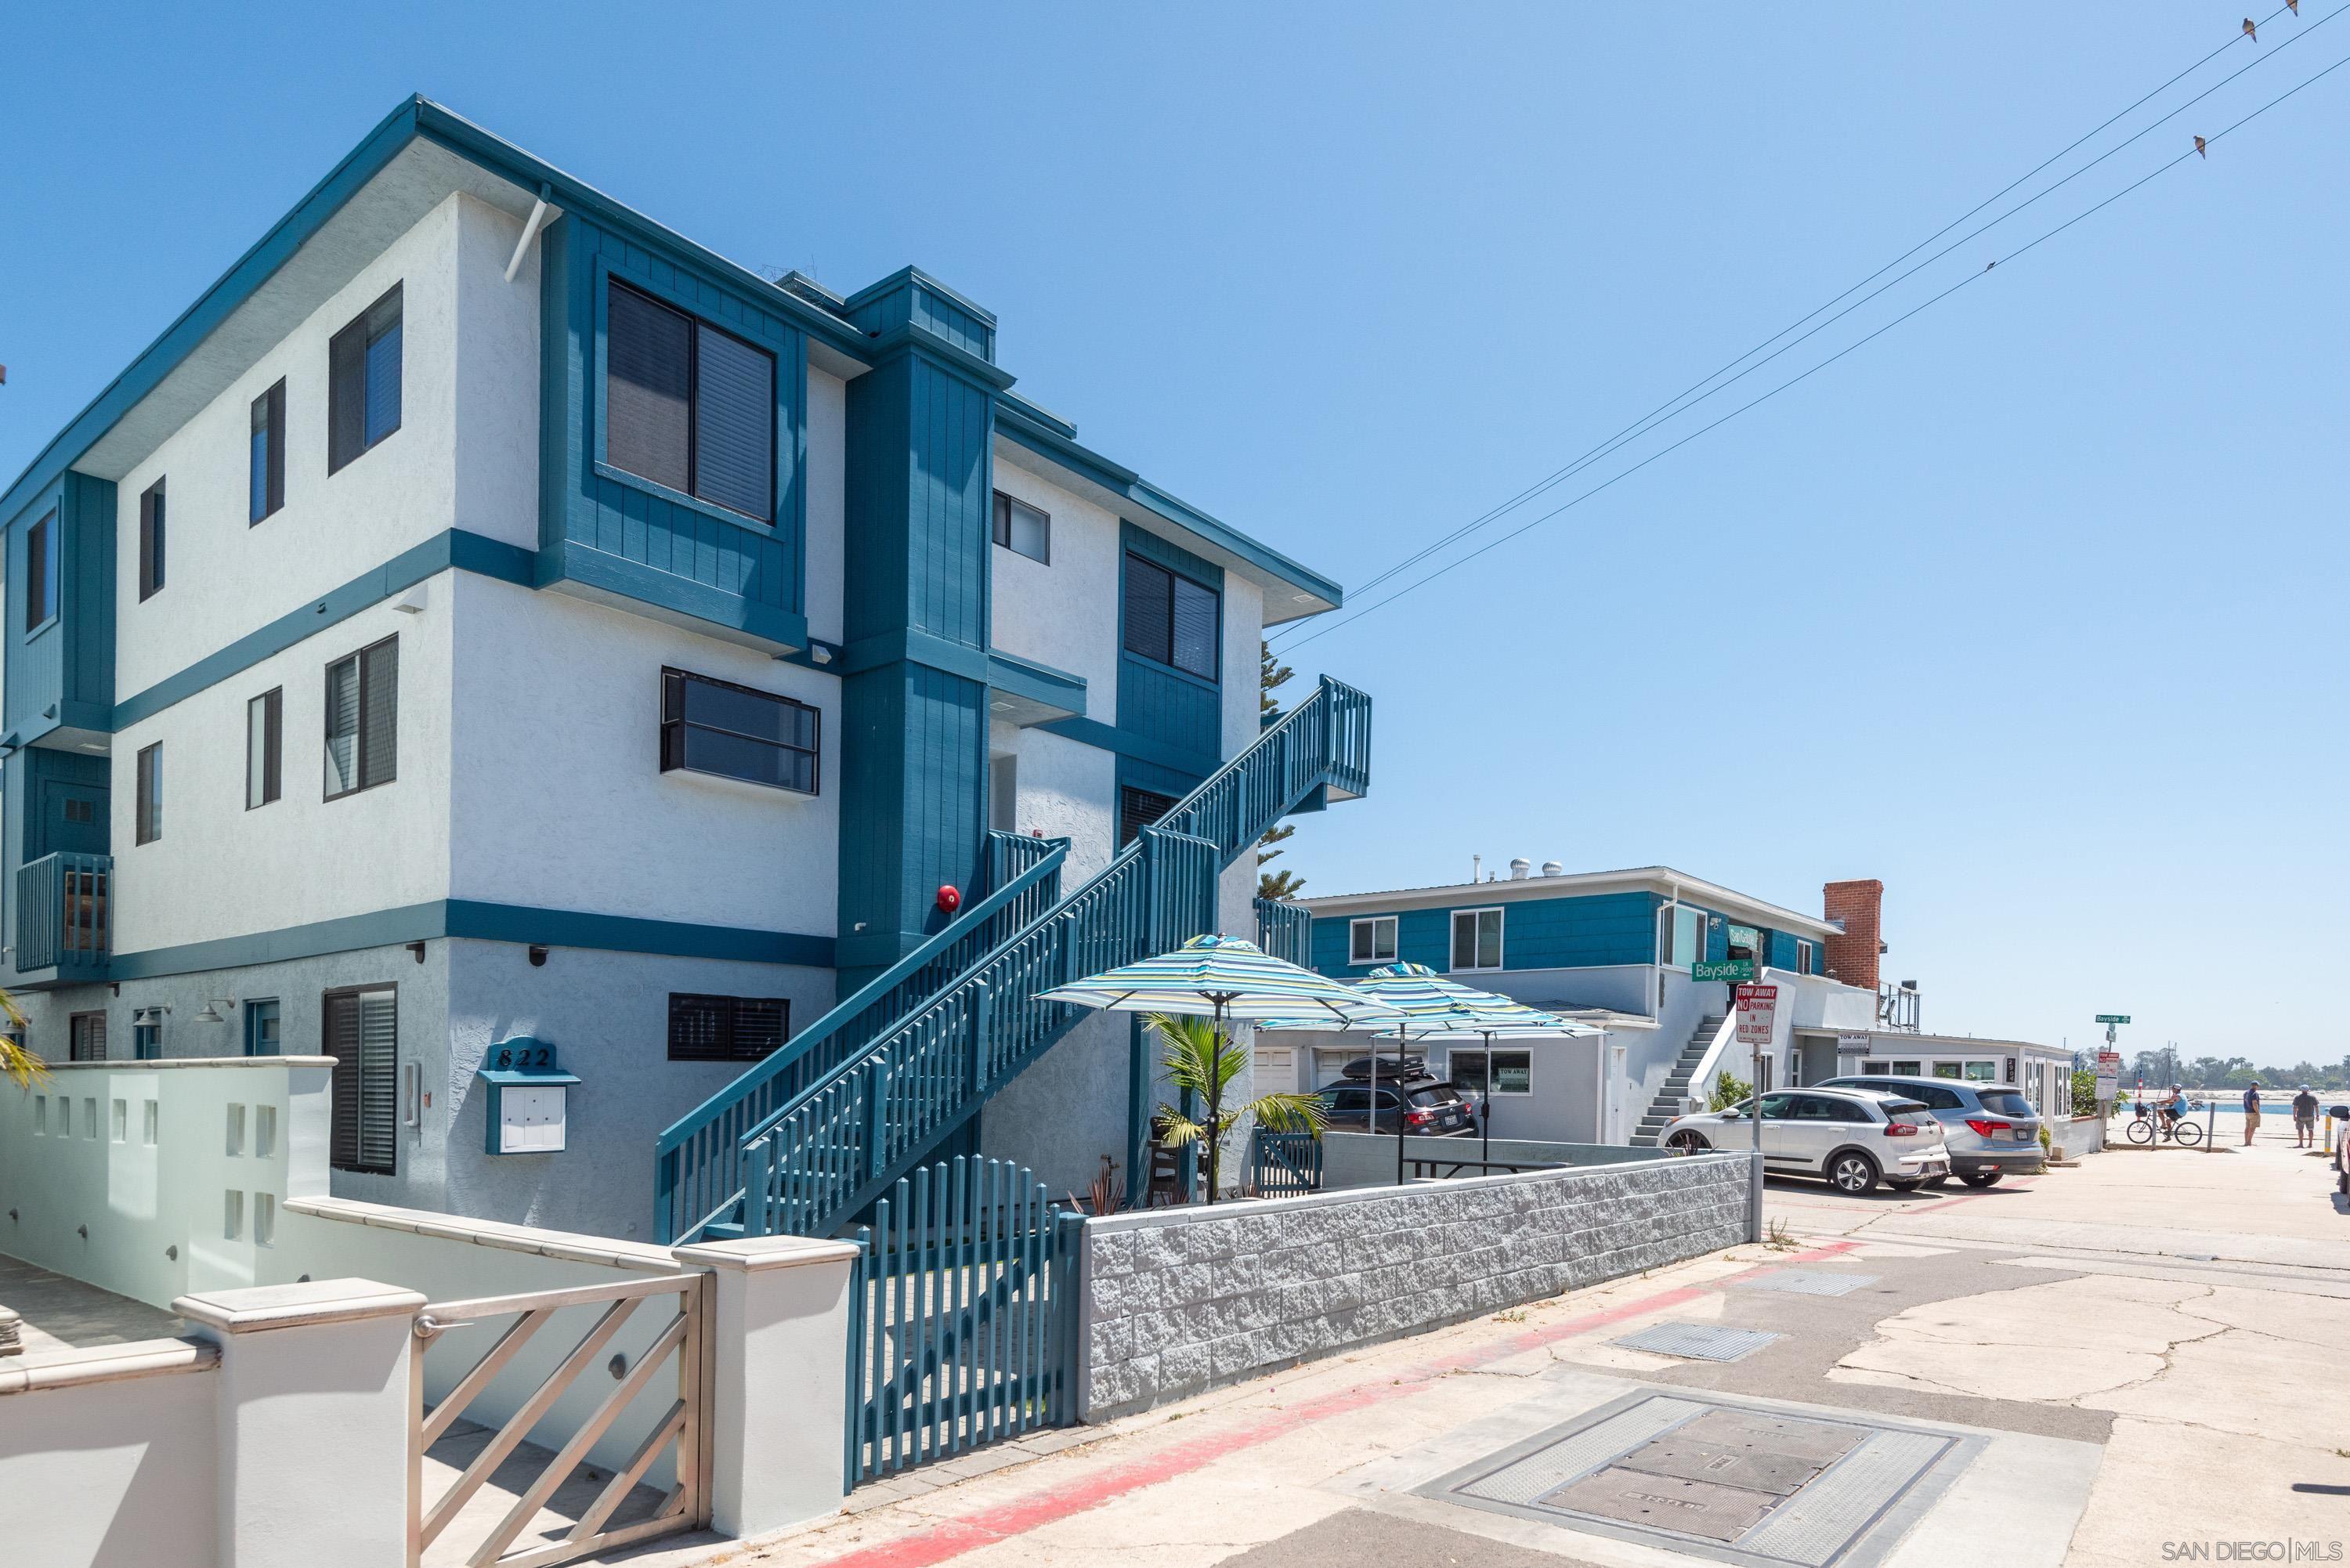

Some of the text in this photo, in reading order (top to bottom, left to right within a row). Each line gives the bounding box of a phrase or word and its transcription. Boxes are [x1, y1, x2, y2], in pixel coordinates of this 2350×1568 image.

[1696, 963, 1738, 980] Bayside
[1738, 988, 1776, 997] TOW AWAY
[1737, 999, 1773, 1011] NO PARKING
[1749, 1013, 1756, 1022] IN
[1739, 1024, 1769, 1034] RED ZONES
[499, 1049, 549, 1067] 822
